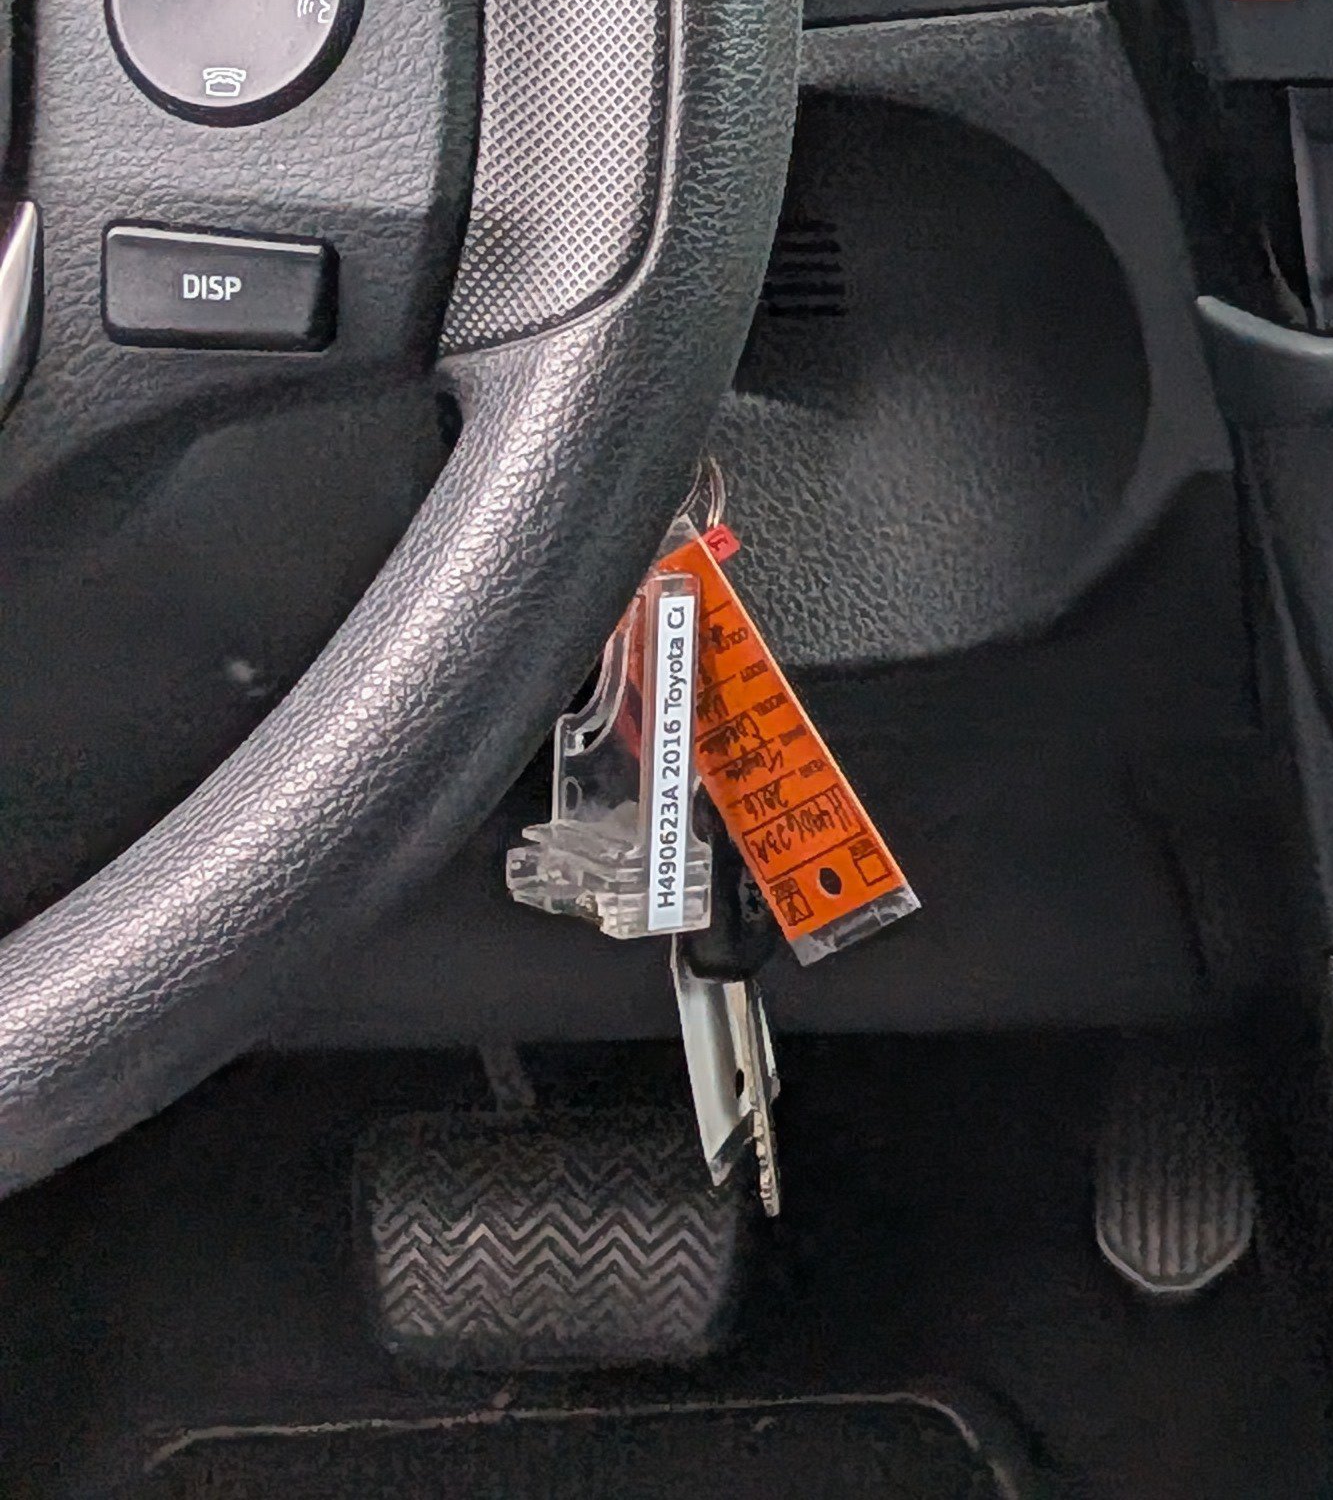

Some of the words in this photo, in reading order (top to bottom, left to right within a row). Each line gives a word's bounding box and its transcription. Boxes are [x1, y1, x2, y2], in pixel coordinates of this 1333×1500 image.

[182, 273, 242, 301] DISP
[664, 636, 688, 716] Toyota
[662, 719, 682, 781] 2016
[657, 784, 679, 909] H490623A
